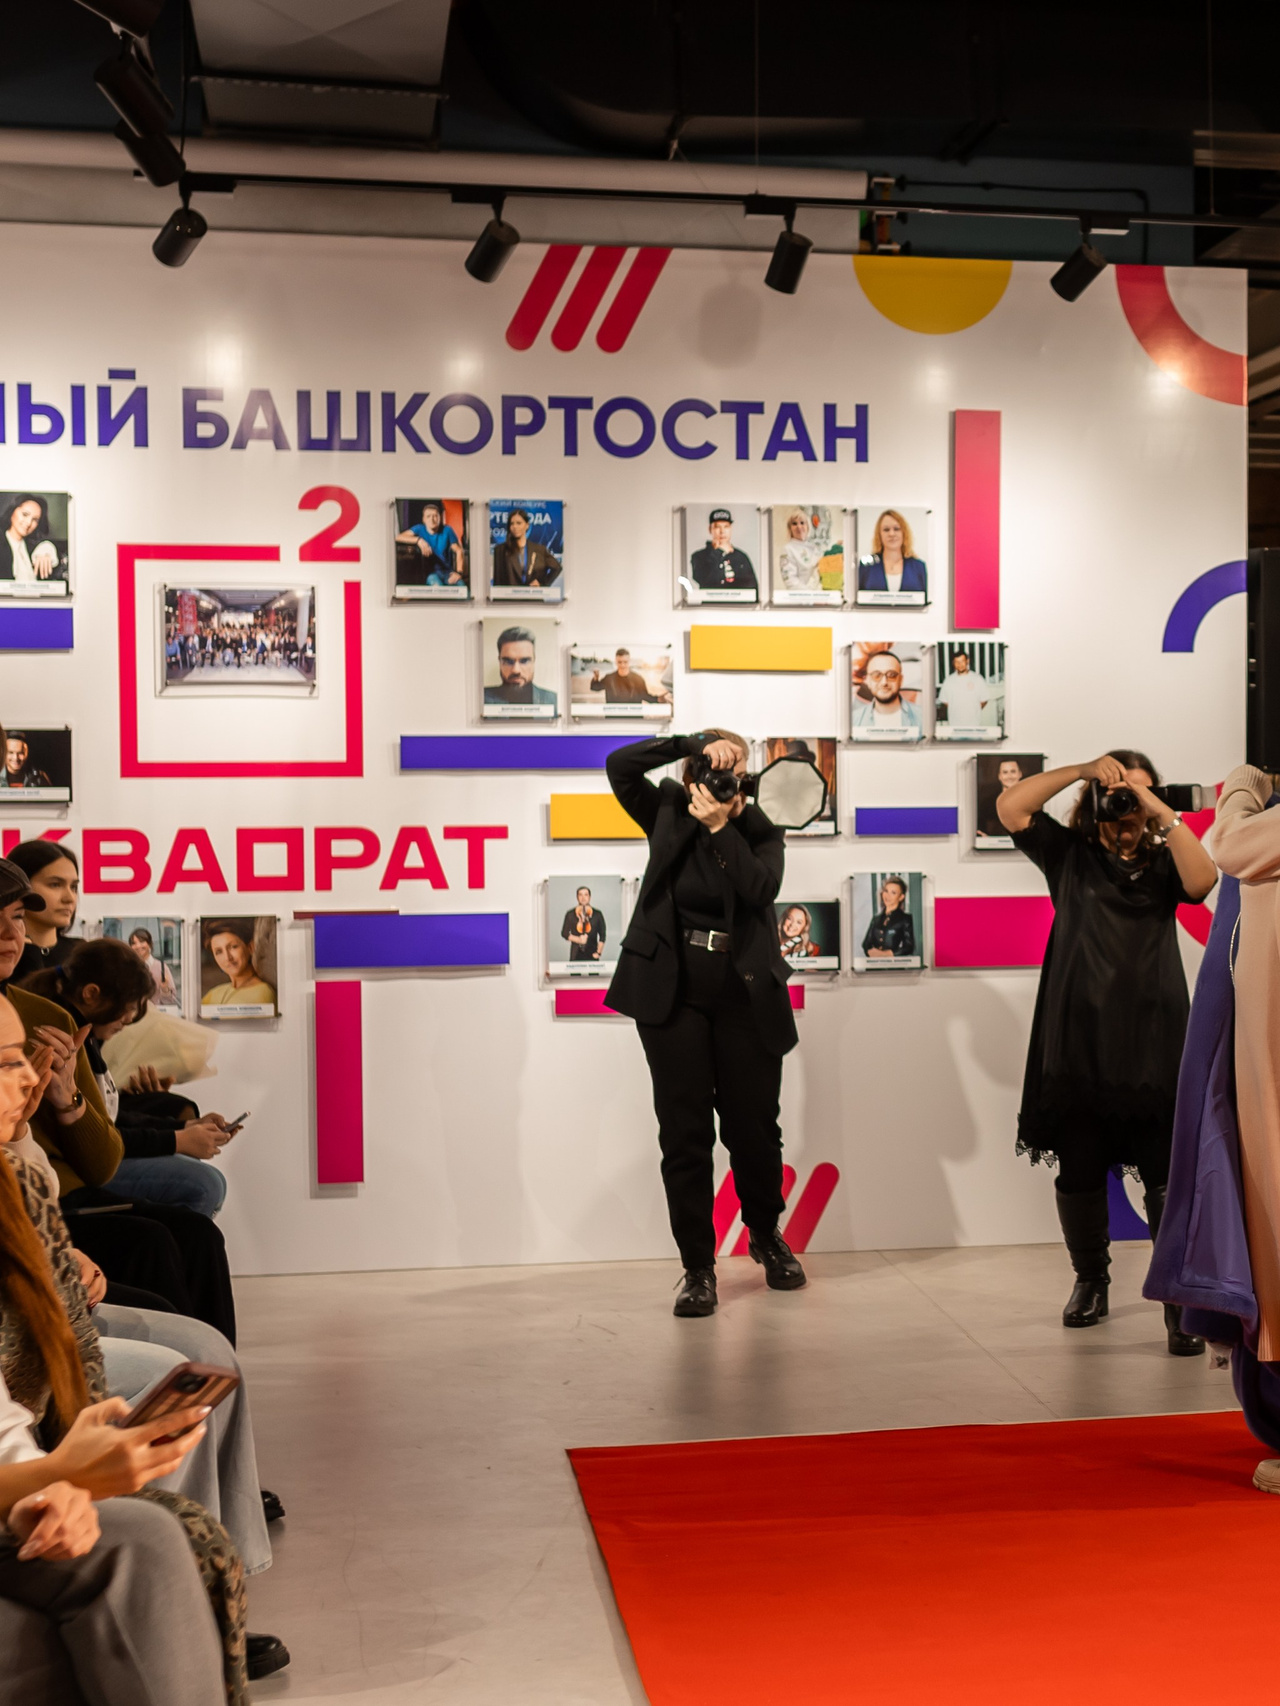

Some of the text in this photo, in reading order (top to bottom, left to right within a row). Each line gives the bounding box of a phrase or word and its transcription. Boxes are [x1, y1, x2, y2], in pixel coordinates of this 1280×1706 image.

[0, 368, 870, 463] ЫЙ БАШКОРТОСТАН
[298, 484, 361, 563] 2
